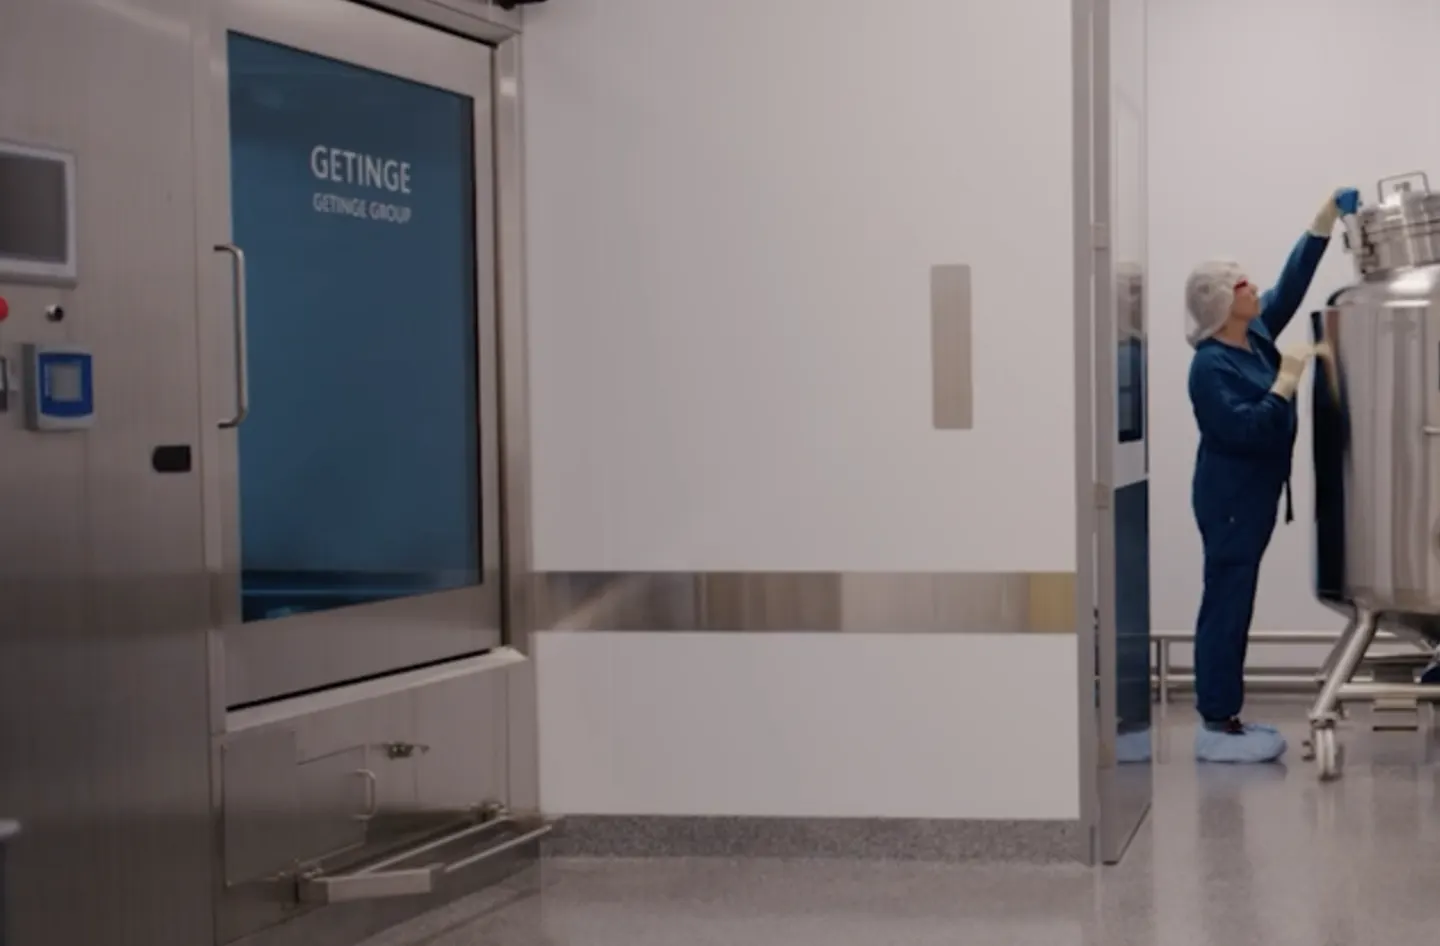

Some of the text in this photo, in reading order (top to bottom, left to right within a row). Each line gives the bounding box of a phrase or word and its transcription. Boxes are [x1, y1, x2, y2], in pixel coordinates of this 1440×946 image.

[311, 144, 412, 194] GETINGE
[313, 193, 412, 224] GETINGE GROUP
